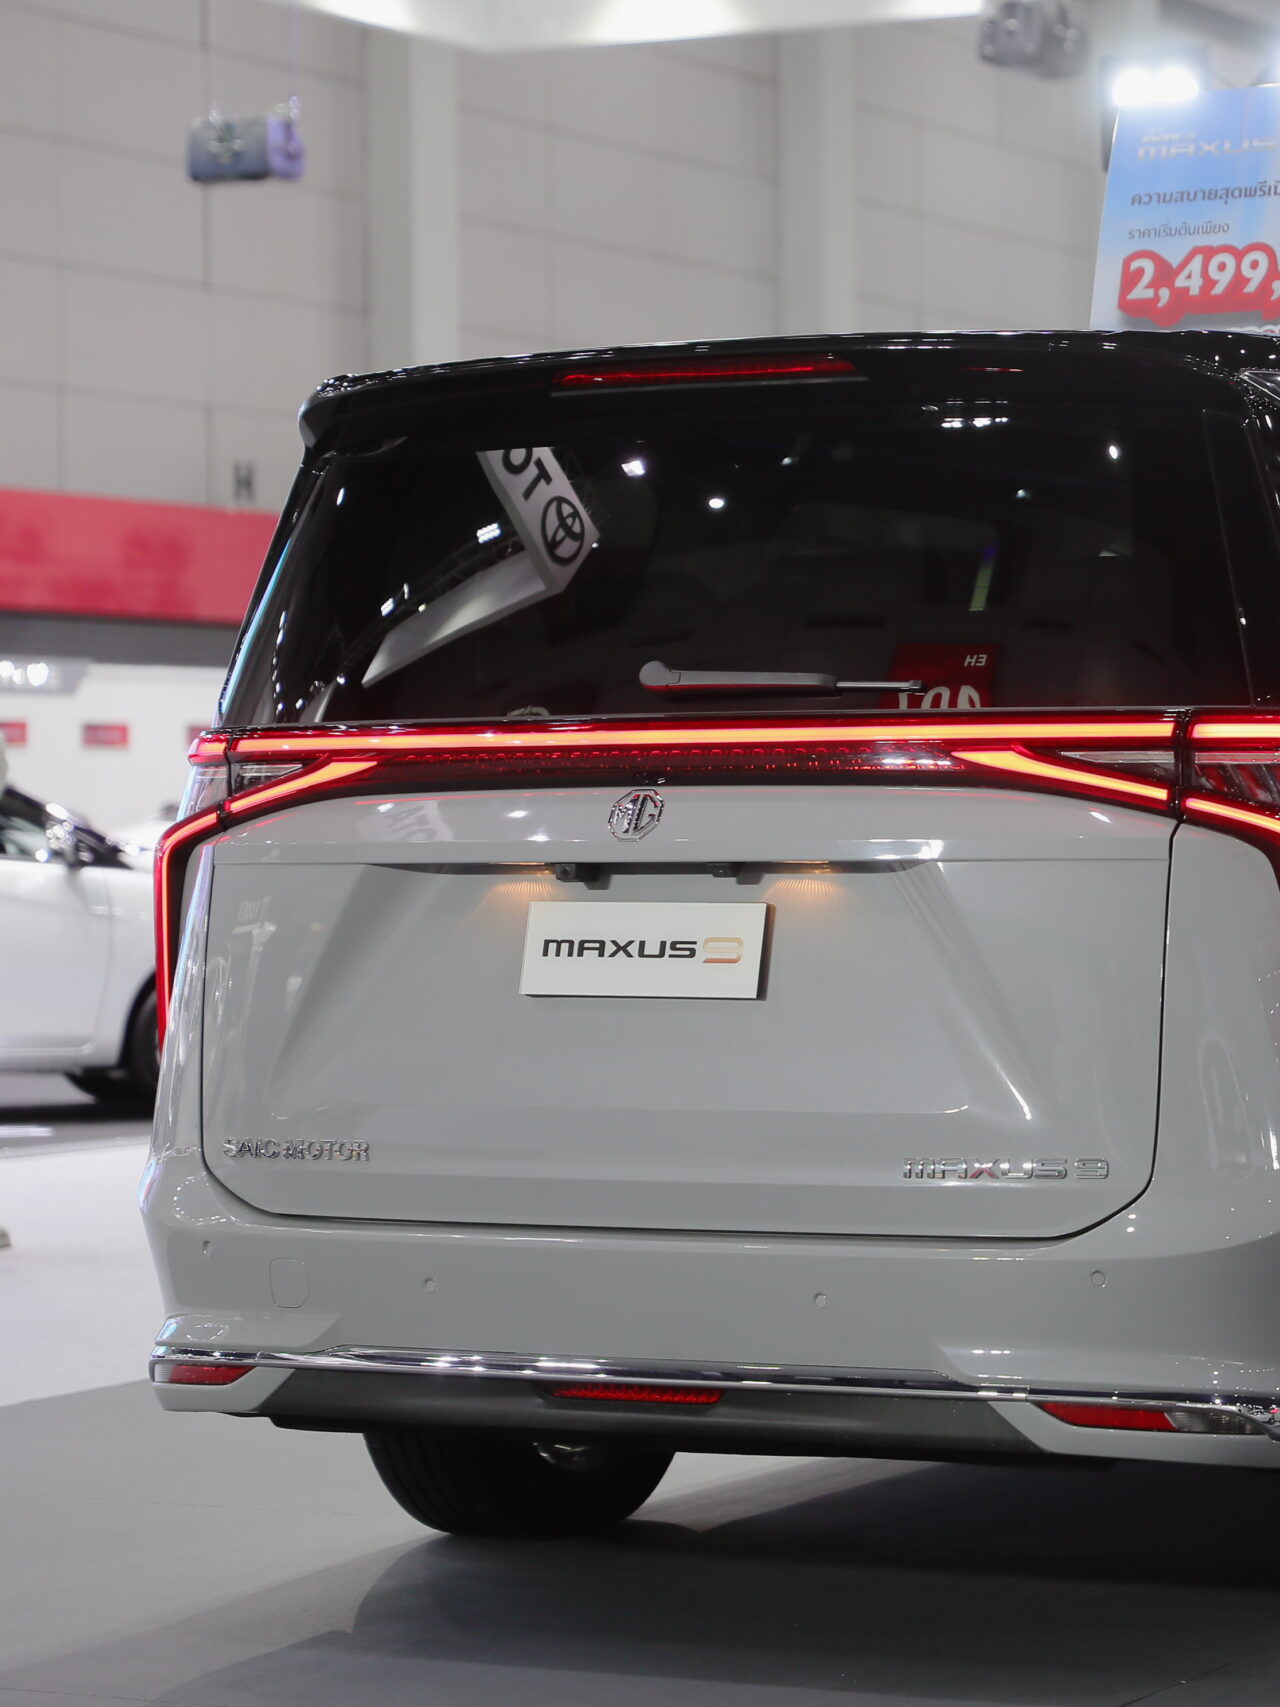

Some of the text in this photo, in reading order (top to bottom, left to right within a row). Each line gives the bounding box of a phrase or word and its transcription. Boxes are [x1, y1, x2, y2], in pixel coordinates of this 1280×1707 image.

[1128, 219, 1231, 241] ราคาเริ่มต้นเพียง
[234, 460, 256, 500] H
[611, 790, 662, 838] MG
[222, 1137, 370, 1162] SAIC MOTOR
[903, 1157, 1110, 1180] MAXUS 9
